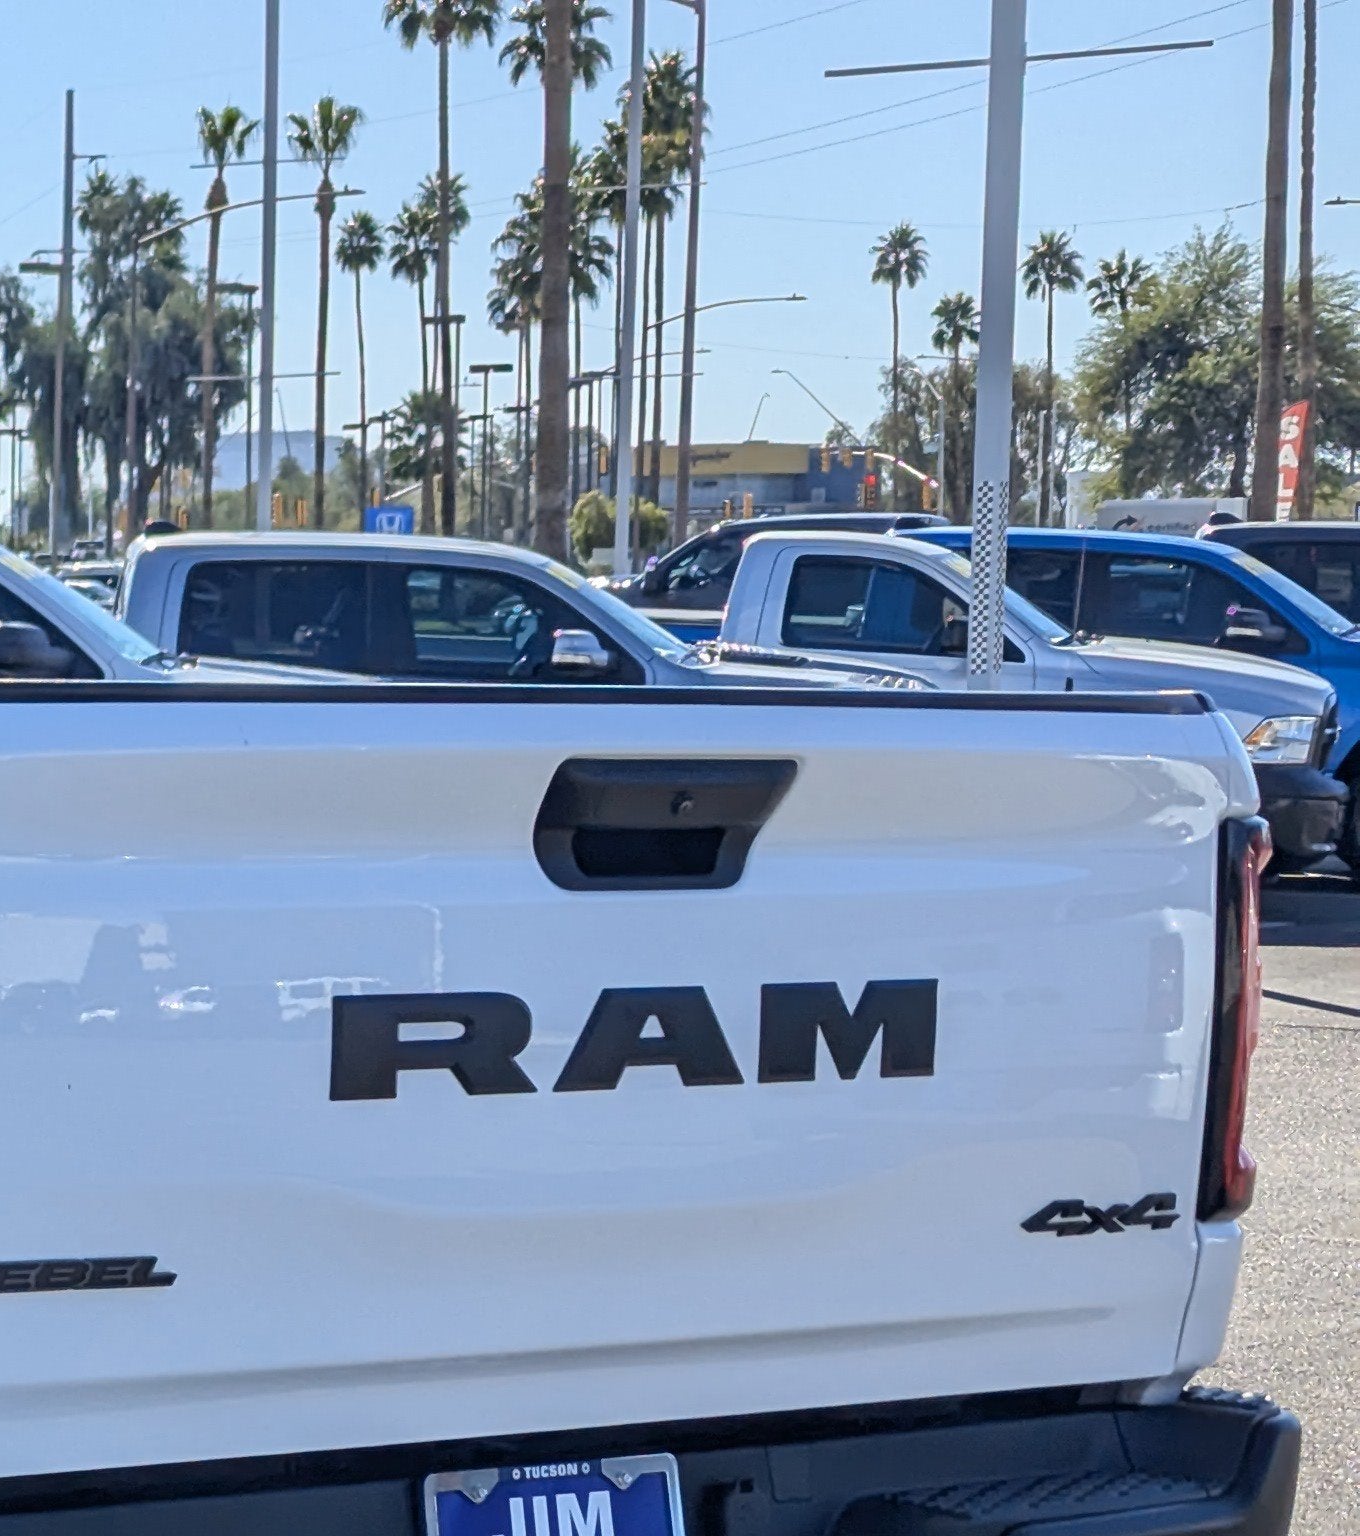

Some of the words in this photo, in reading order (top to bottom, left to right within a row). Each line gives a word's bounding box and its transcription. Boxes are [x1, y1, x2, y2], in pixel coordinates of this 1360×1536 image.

[1275, 416, 1300, 522] SALE
[329, 979, 939, 1101] RAM
[1020, 1192, 1181, 1237] 4x4
[523, 1462, 578, 1480] TUCSON
